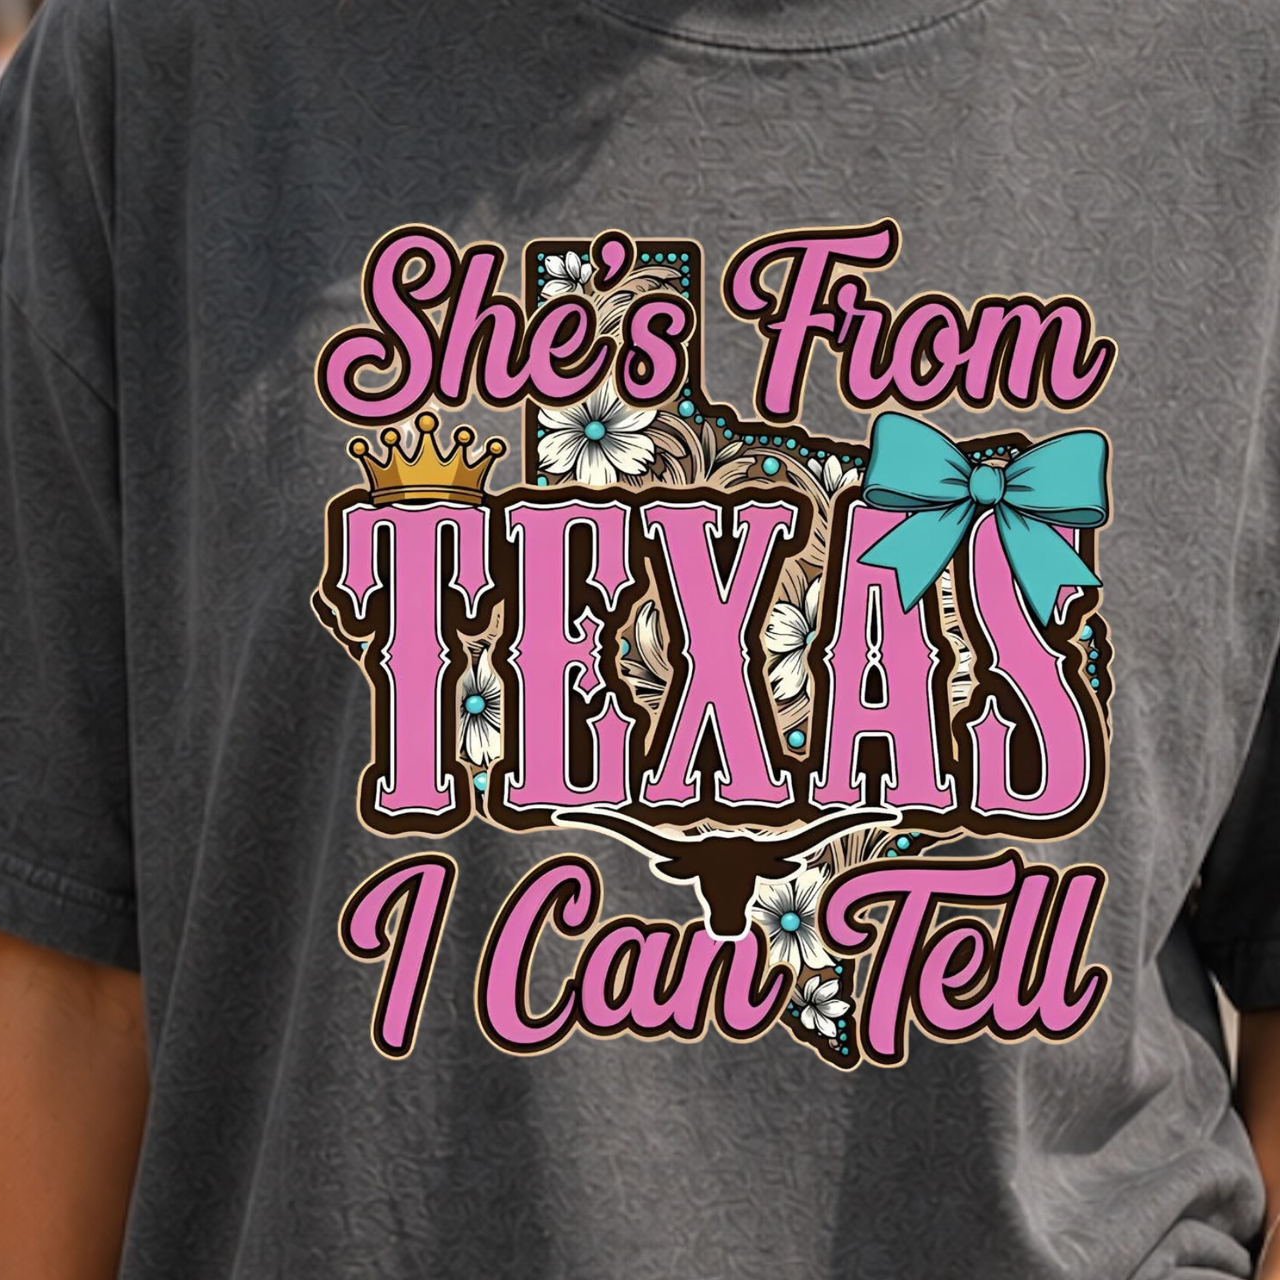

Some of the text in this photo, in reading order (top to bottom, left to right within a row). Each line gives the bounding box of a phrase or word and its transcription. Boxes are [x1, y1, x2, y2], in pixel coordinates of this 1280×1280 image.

[322, 222, 1116, 420] She's From
[340, 498, 1094, 820] TEXAS
[342, 854, 1106, 1060] I Can Tell
